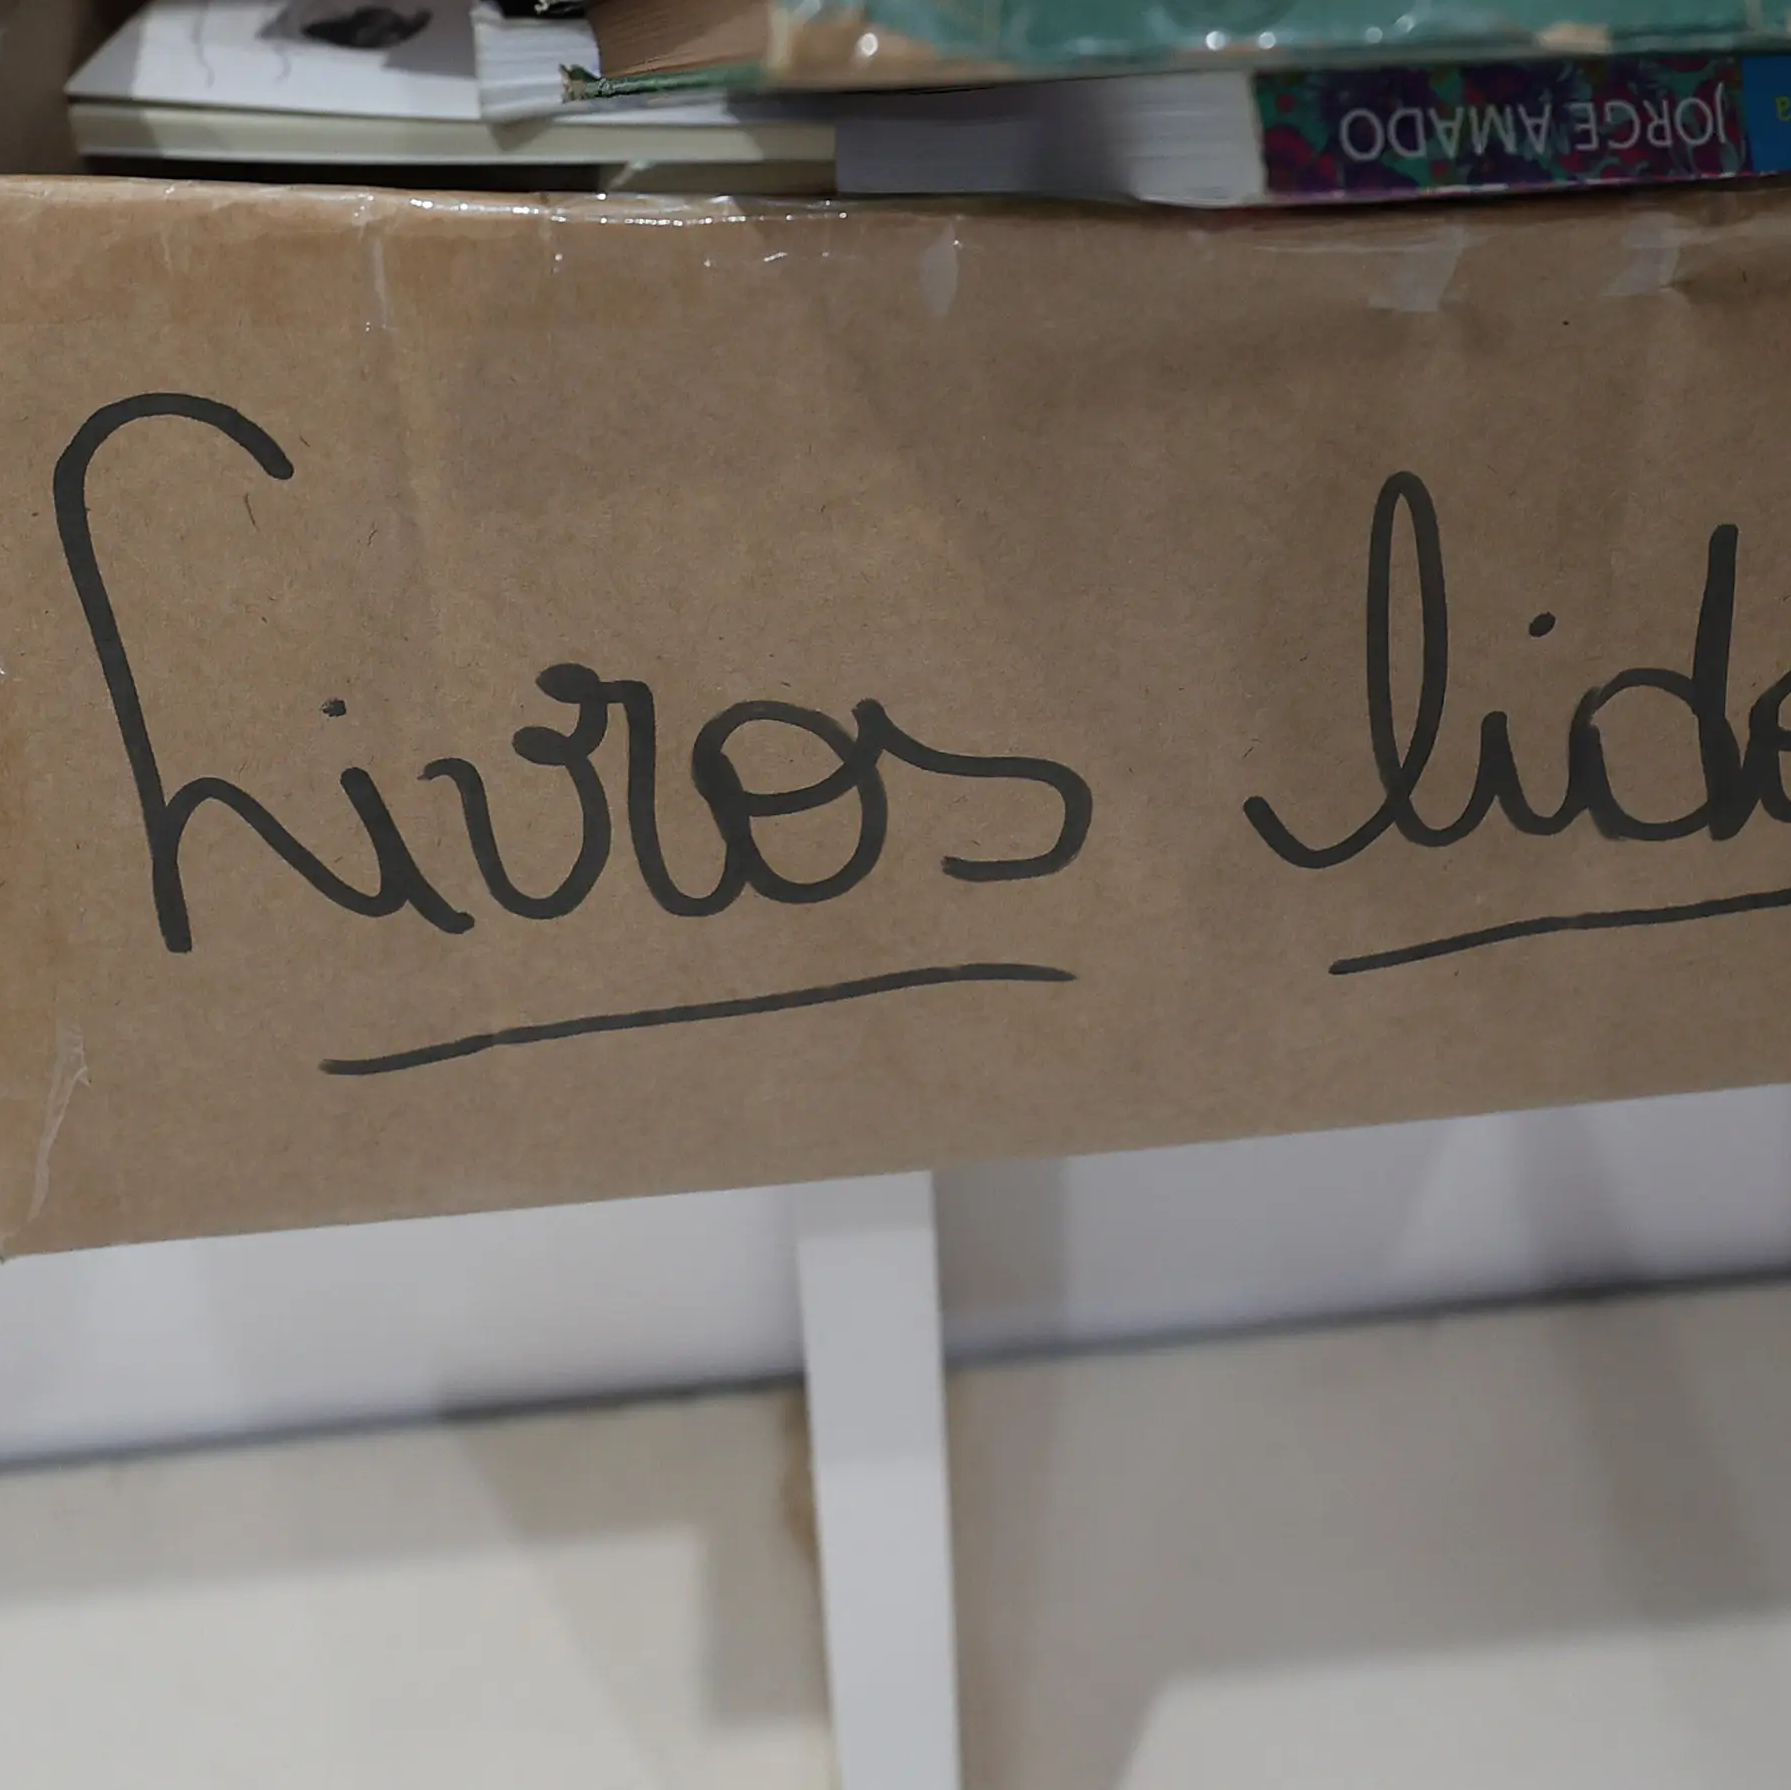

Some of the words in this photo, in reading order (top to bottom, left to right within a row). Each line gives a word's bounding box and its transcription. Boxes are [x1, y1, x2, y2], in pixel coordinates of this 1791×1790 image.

[1338, 98, 1552, 161] AMADO
[1566, 81, 1728, 152] JORGE
[54, 390, 1093, 954] Livros
